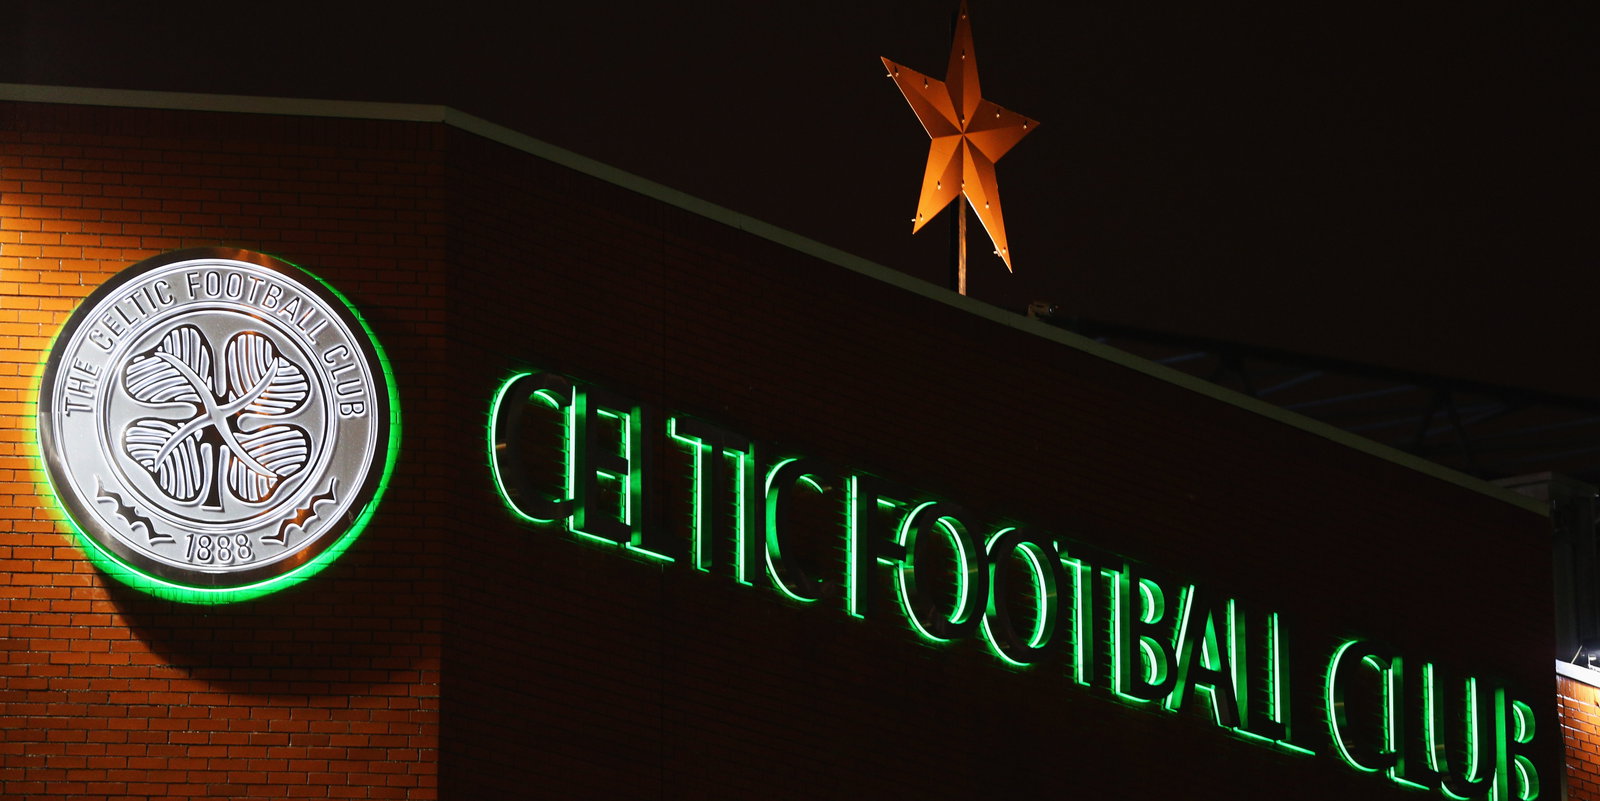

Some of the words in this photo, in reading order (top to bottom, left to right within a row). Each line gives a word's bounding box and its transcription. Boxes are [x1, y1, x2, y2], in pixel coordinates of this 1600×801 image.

[64, 357, 102, 418] THE
[88, 279, 177, 355] CELTIC
[185, 270, 330, 345] FOOTBALL
[322, 343, 368, 418] CLUB
[184, 531, 254, 563] 1888
[488, 371, 838, 605] CELTIC
[844, 473, 1316, 757] FOOTBALL
[1324, 639, 1544, 801] CLUB
